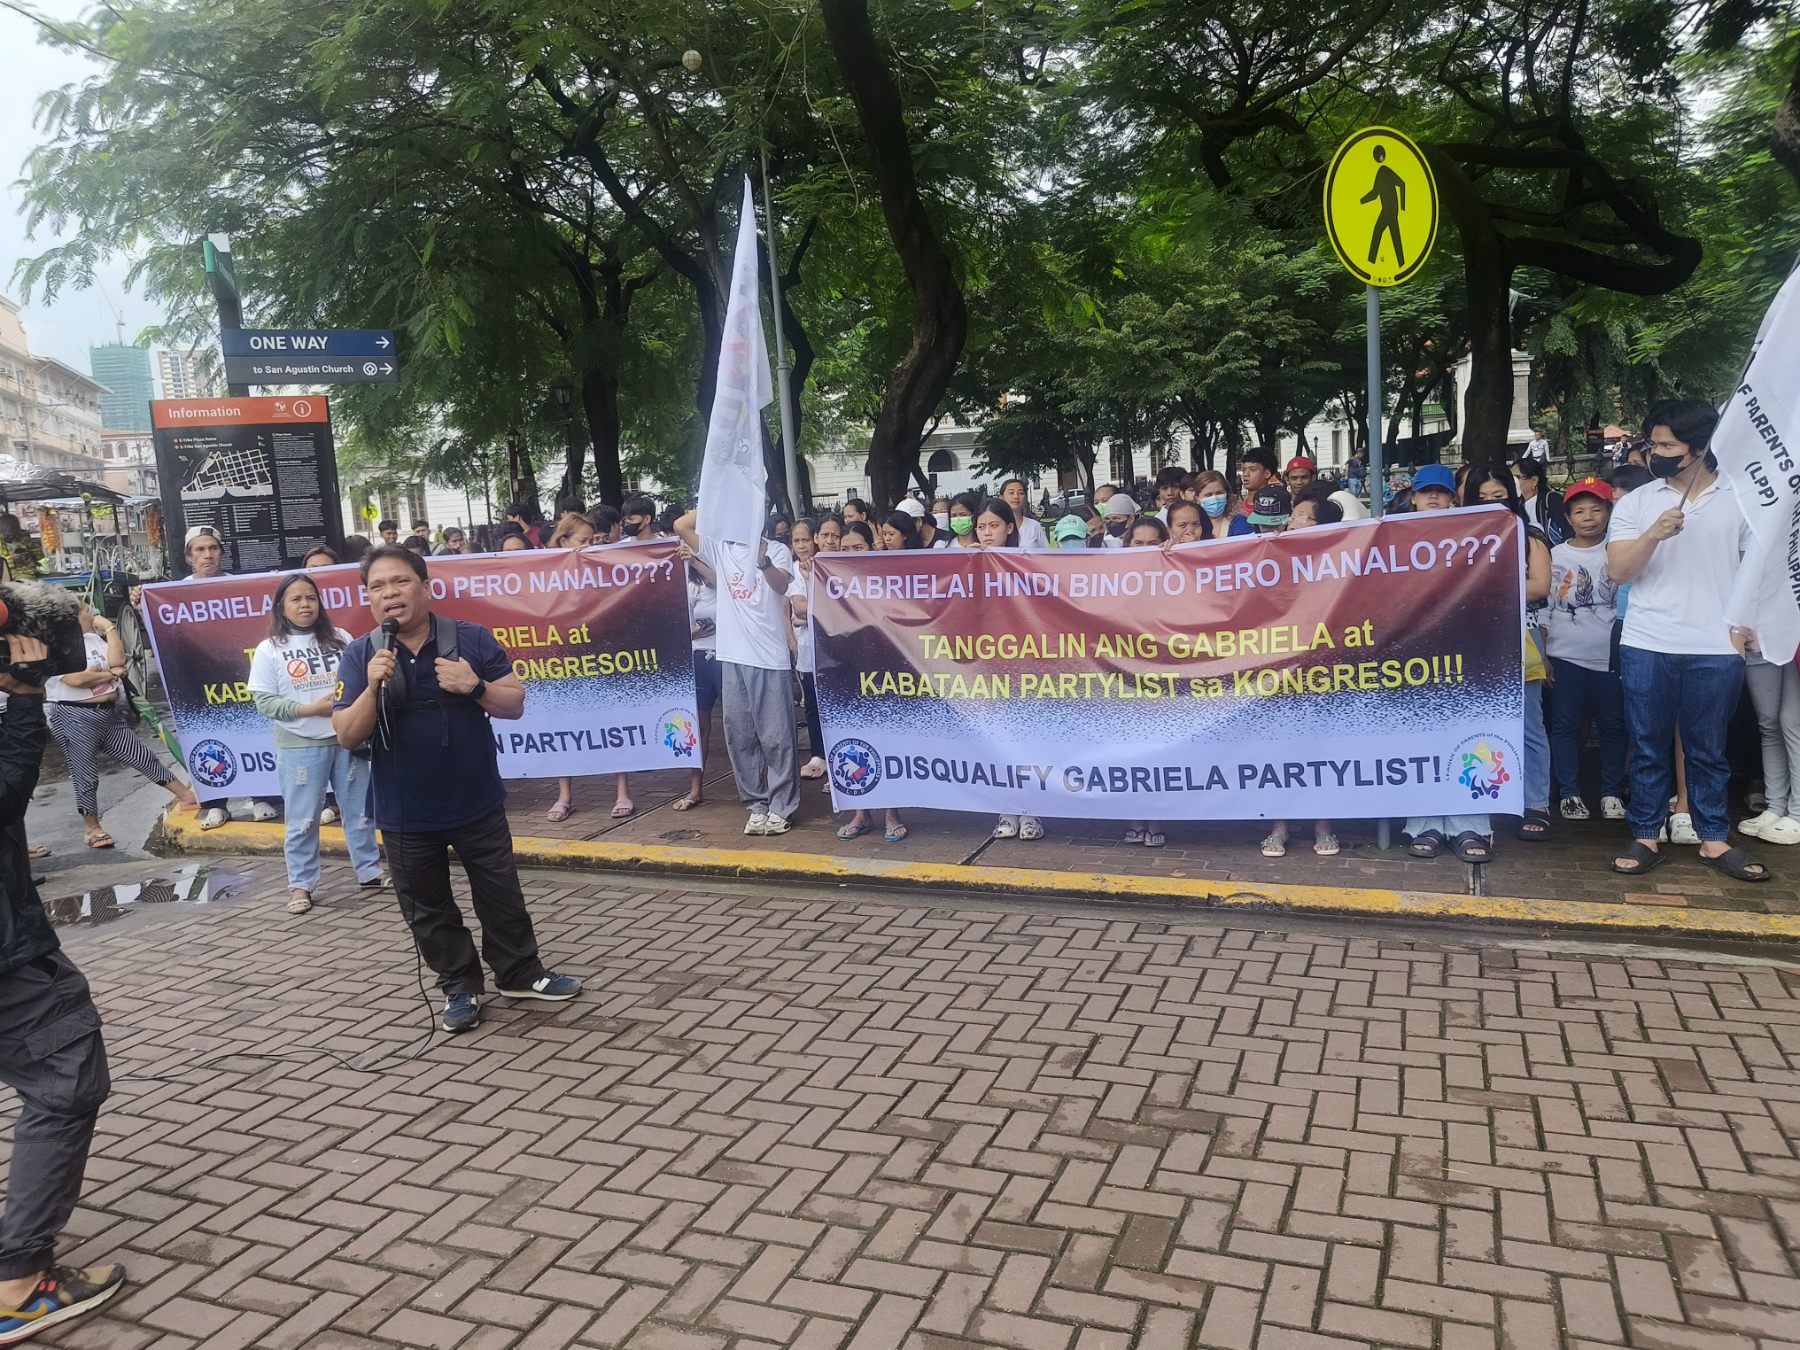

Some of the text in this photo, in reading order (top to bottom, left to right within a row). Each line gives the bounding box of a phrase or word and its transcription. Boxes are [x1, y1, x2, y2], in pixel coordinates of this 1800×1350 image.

[250, 336, 328, 350] ONE WAY
[253, 364, 354, 375] to San Agustin Church
[168, 406, 241, 419] Information
[1745, 396, 1795, 473] PARENTS
[1744, 461, 1779, 507] (LPP)
[453, 573, 522, 599] PERO
[529, 560, 675, 594] NANALO???
[825, 534, 1502, 600] GABRIELA! HINDI BINOTO PERO NANALO???
[491, 622, 592, 648] RIELA at
[918, 619, 1375, 661] TANGGALIN ANG GABRIELA at
[511, 648, 659, 682] ONGRESO!!!
[859, 654, 1463, 700] KABATAAN PARTYLIST sa KONGRESO!!!
[510, 724, 648, 755] PARTYLIST!
[885, 755, 1441, 793] DISQUALIFY GABRIELA PARTYLIST!
